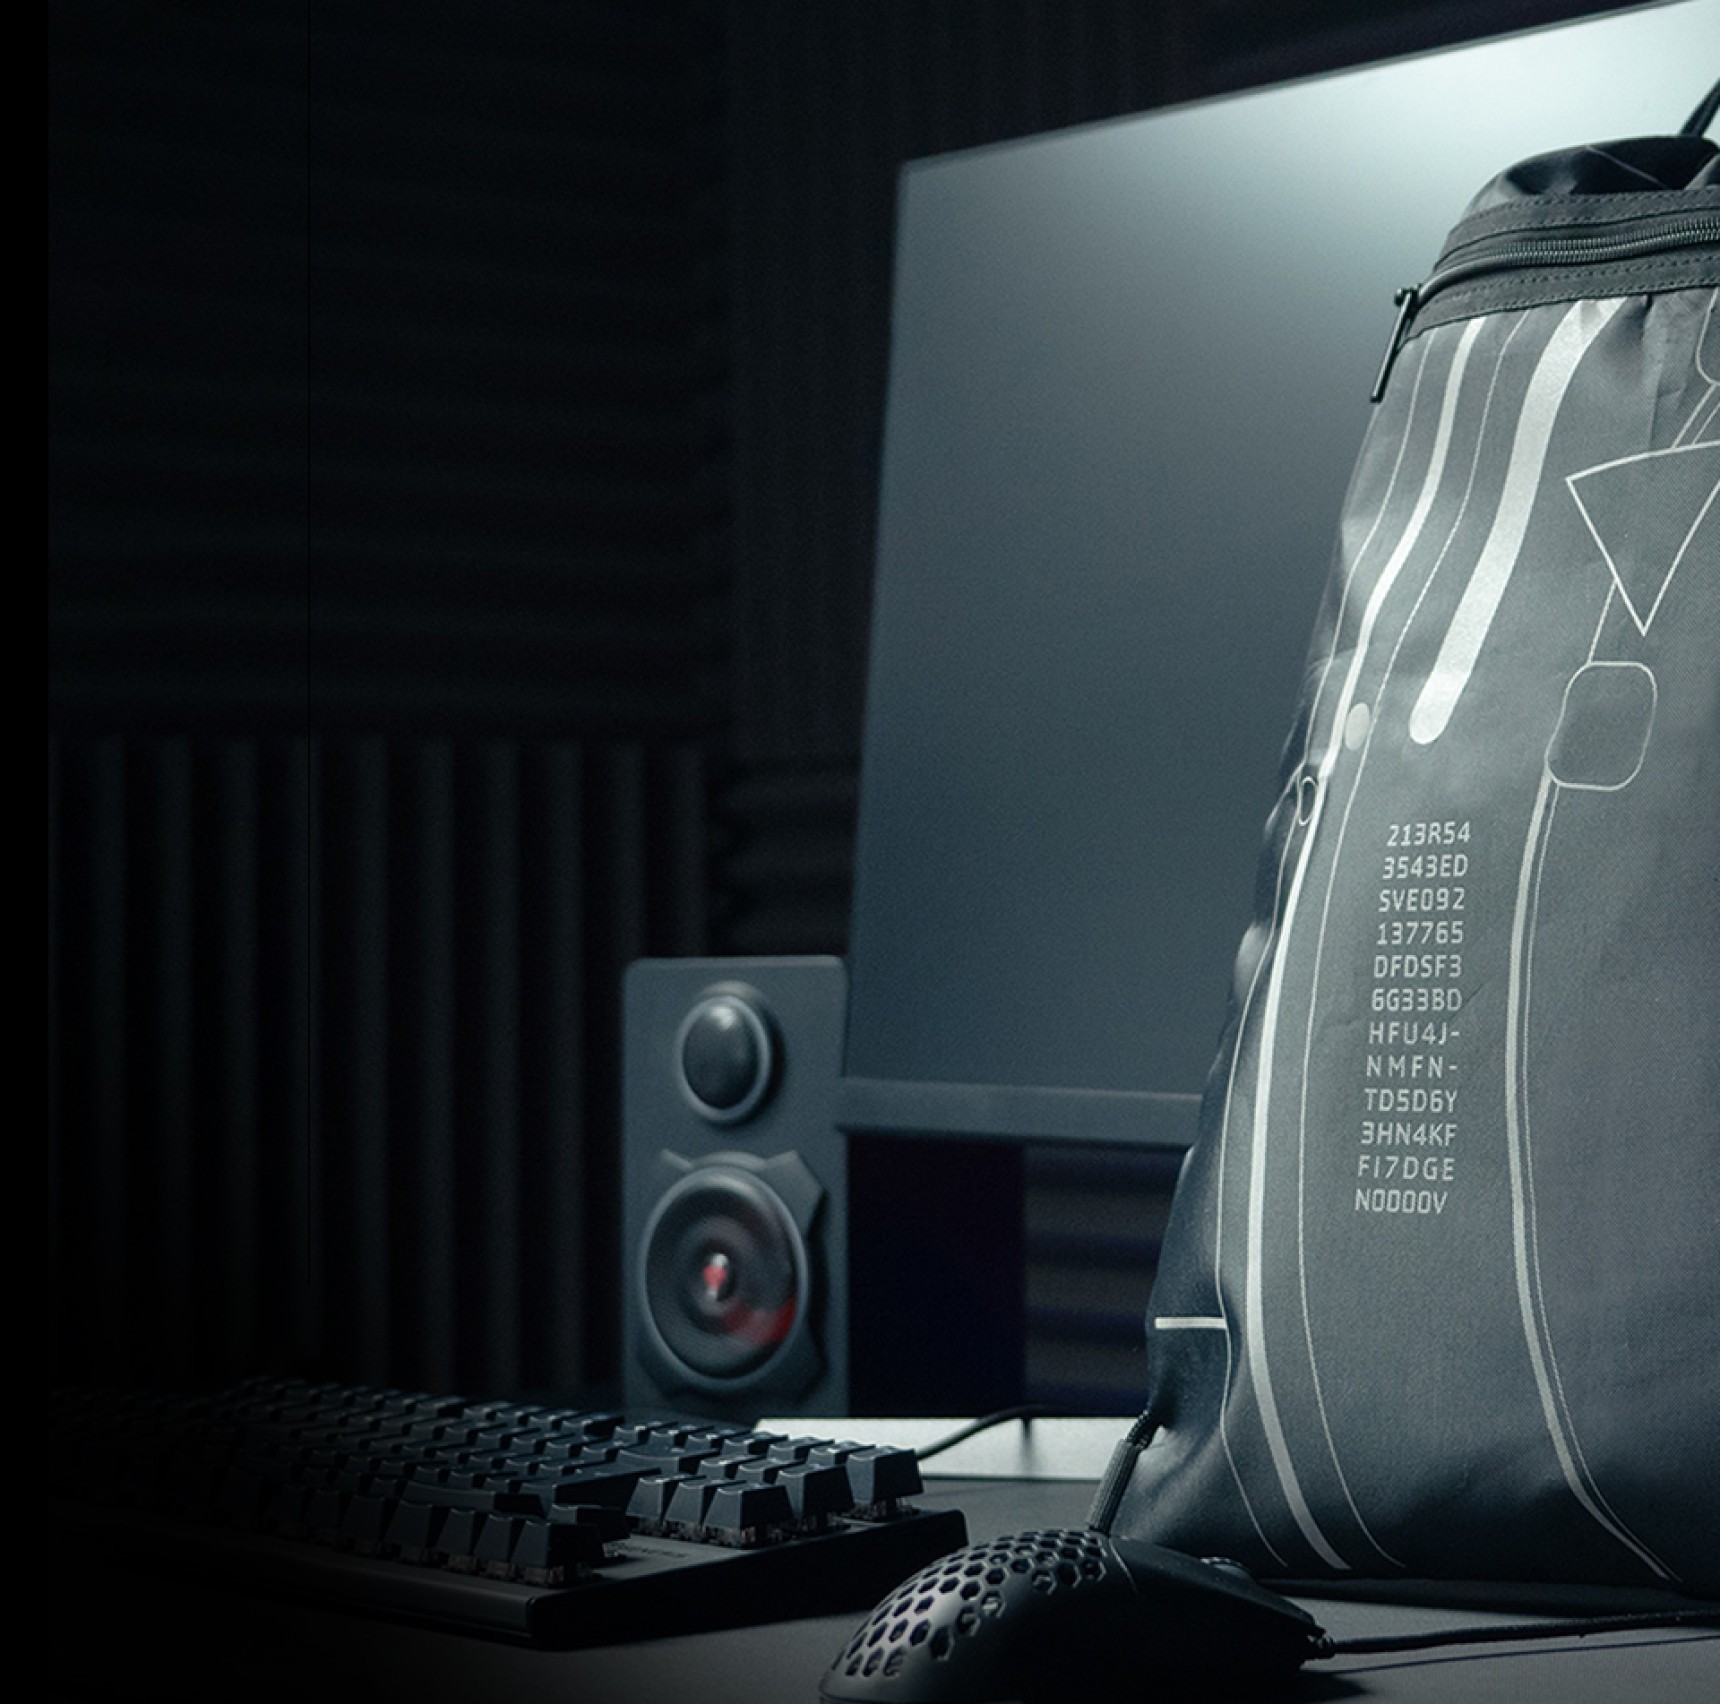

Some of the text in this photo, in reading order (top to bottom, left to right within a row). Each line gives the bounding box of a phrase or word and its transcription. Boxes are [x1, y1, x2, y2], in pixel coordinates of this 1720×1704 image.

[1386, 821, 1471, 847] 213R54
[1382, 854, 1469, 879] 3543ED
[1376, 920, 1464, 945] 137765
[1374, 954, 1462, 978] DFDSF3
[1371, 988, 1462, 1011] 6G33BD
[1368, 1022, 1460, 1045] HFU4J-
[1364, 1088, 1458, 1113] TD5D6Y
[1361, 1121, 1458, 1146] 3HN4KF
[1358, 1154, 1456, 1181] FI7DGE
